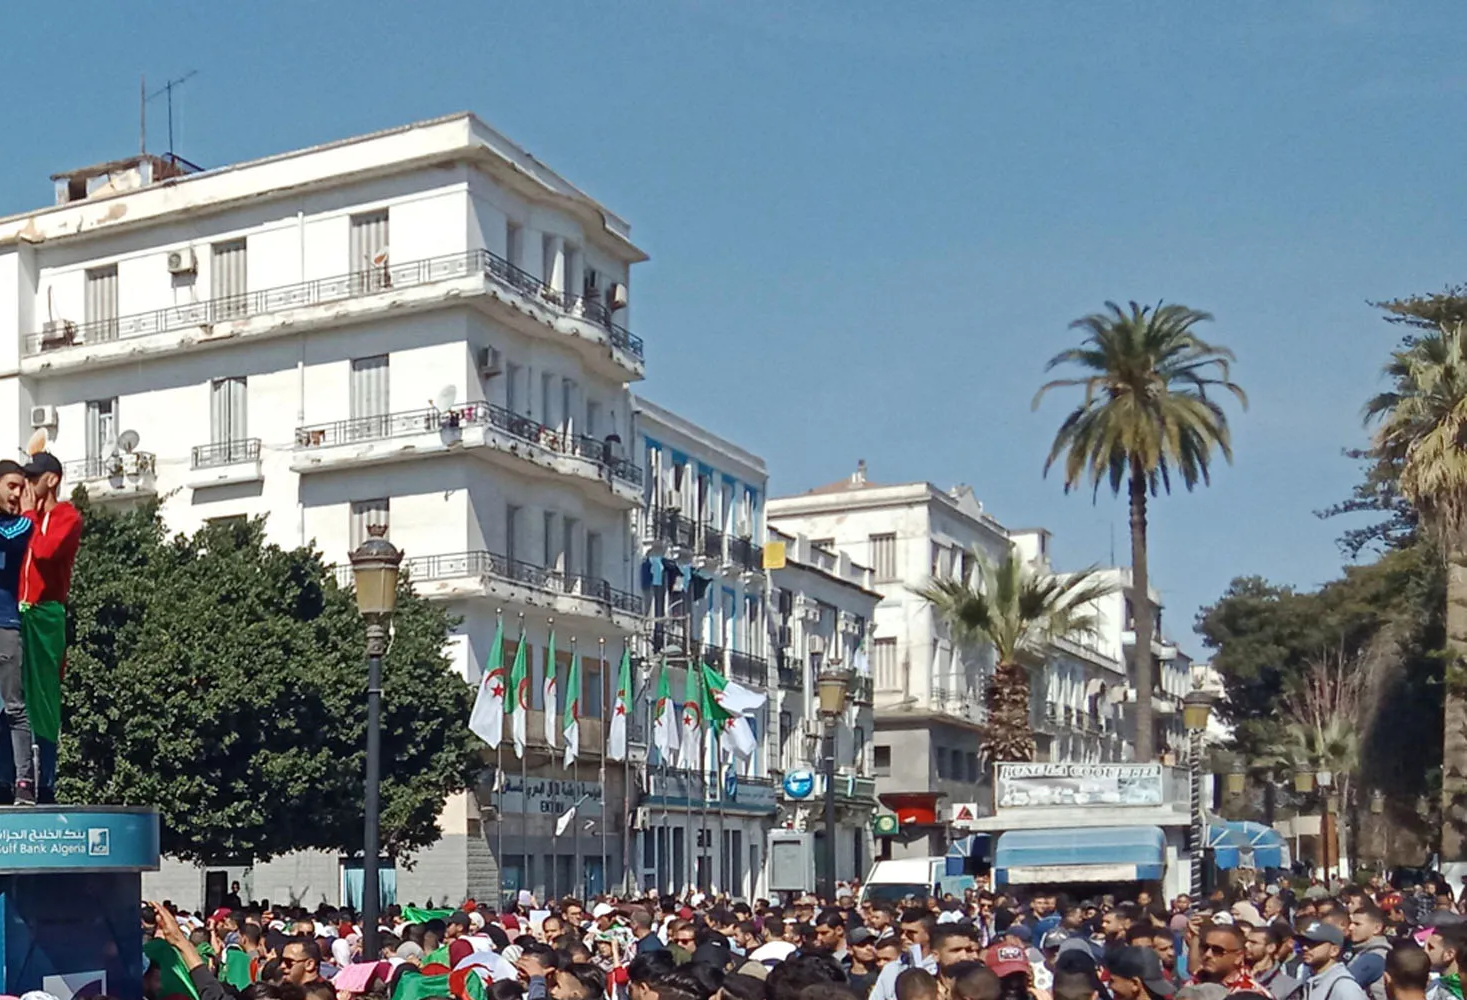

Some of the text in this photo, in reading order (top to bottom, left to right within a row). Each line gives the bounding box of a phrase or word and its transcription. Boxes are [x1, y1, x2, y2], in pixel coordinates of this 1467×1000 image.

[29, 828, 62, 842] الخليج
[63, 828, 86, 840] بنك
[20, 843, 47, 855] Bank
[50, 843, 86, 857] Algeria
